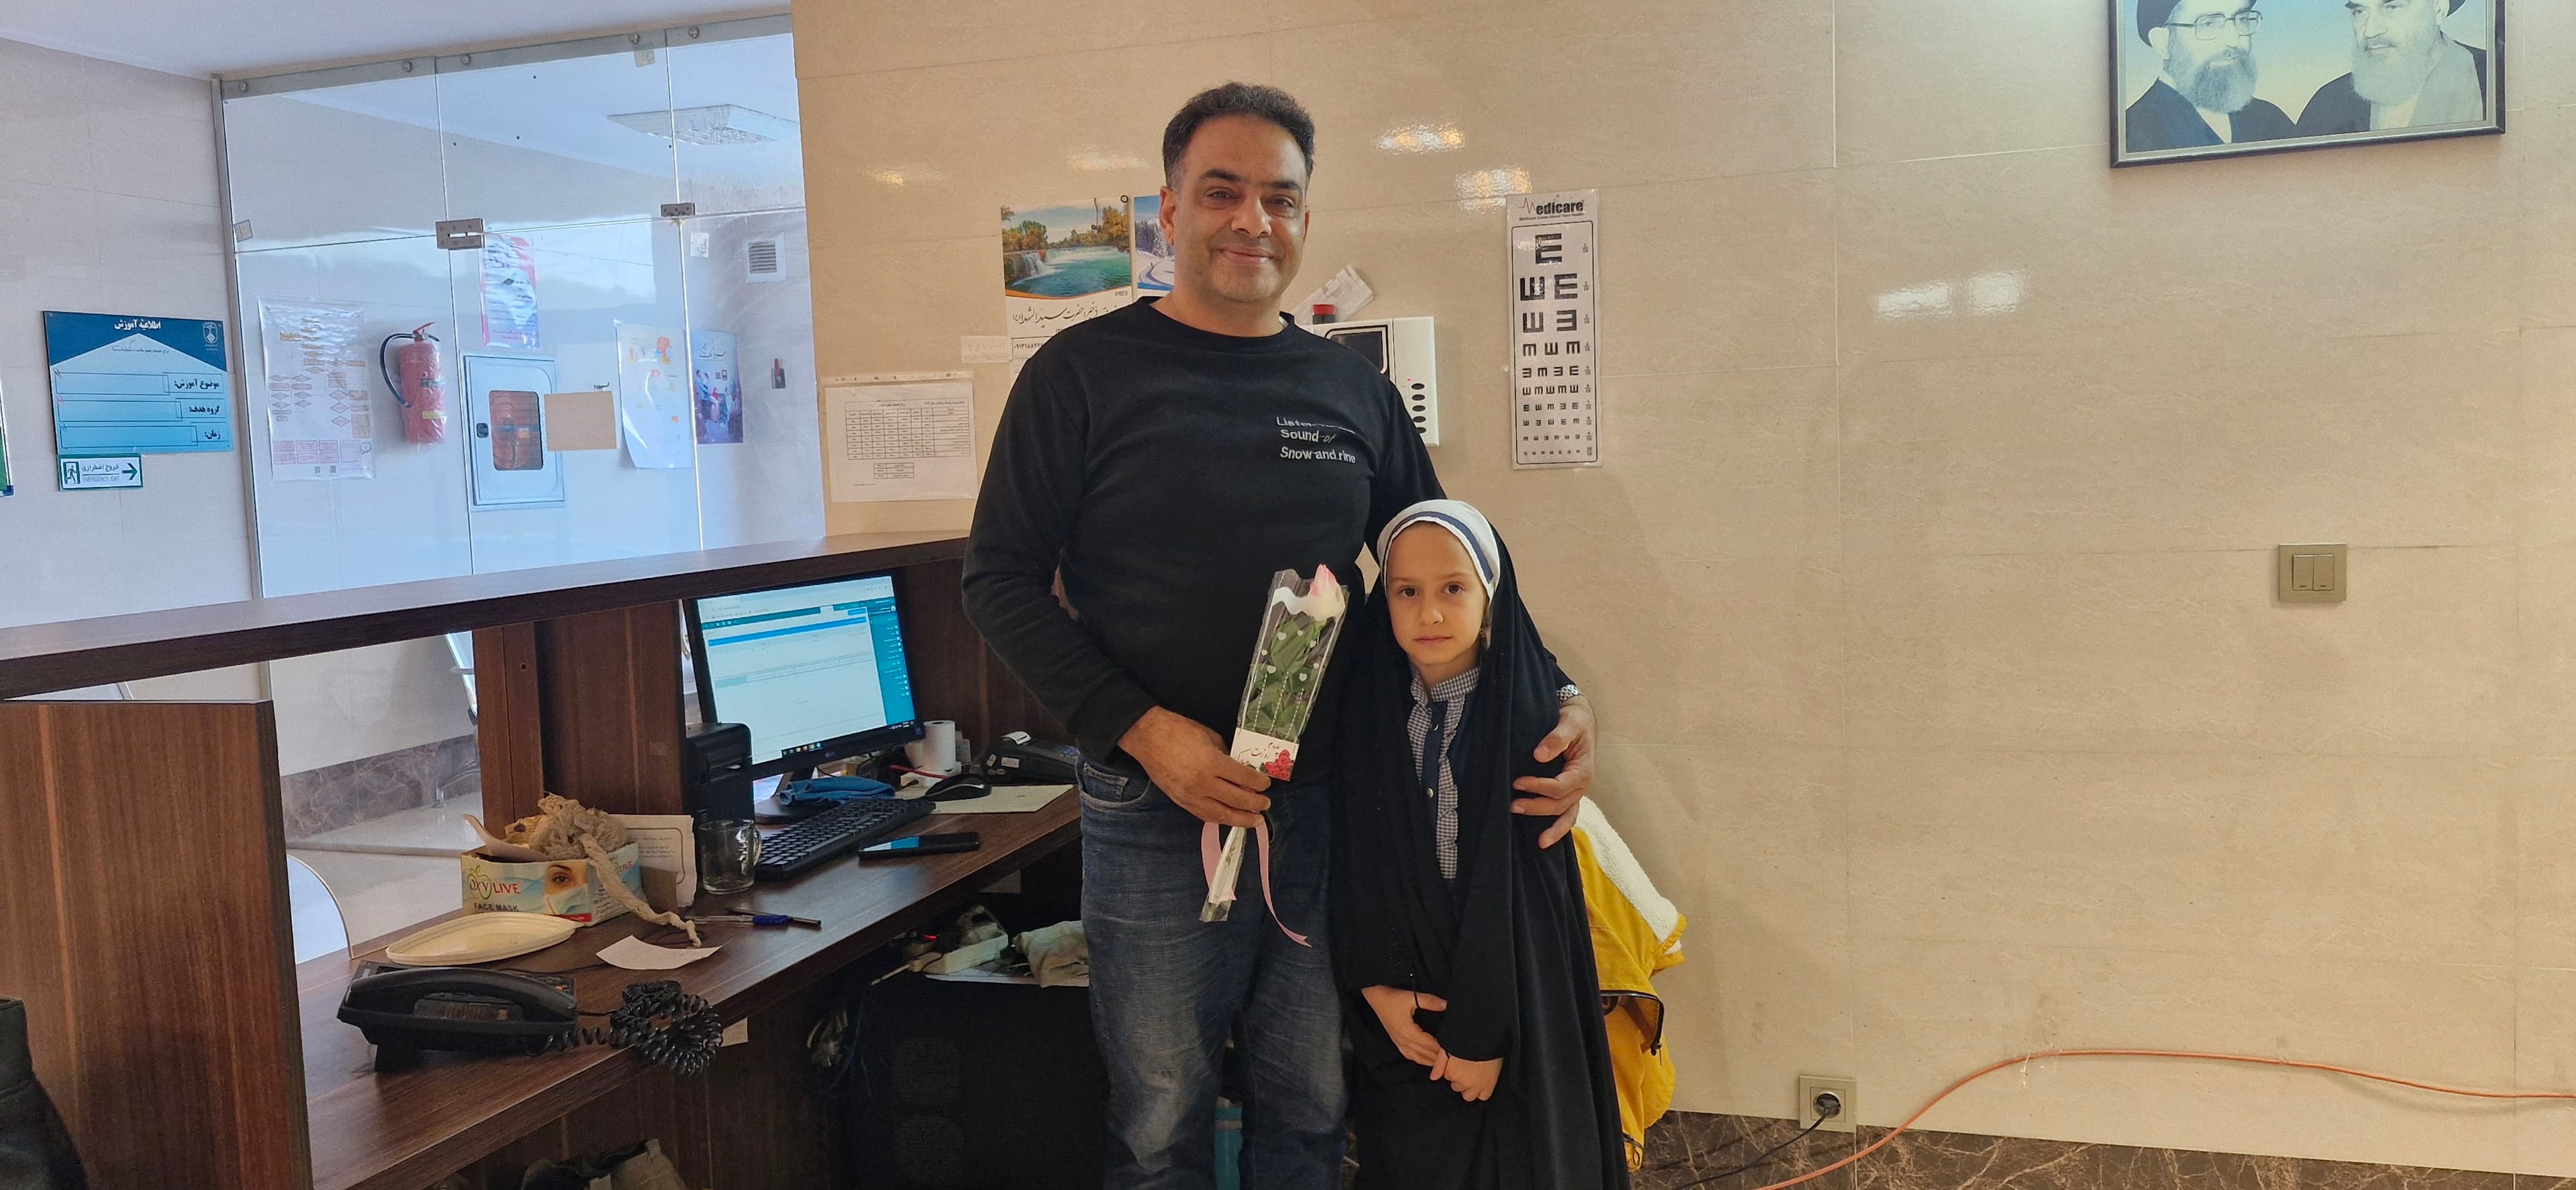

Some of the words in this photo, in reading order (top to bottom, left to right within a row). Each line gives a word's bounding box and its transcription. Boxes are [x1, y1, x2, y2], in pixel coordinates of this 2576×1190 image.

[114, 318, 138, 330] آموزش
[199, 380, 219, 389] موضوع
[207, 405, 220, 415] گروه
[1280, 429, 1320, 443] Sound
[1280, 446, 1312, 460] Snow
[1316, 449, 1336, 460] and
[81, 464, 104, 472] اضطراری
[105, 464, 119, 472] خروج
[474, 902, 494, 911] FACE
[495, 904, 521, 913] MASK
